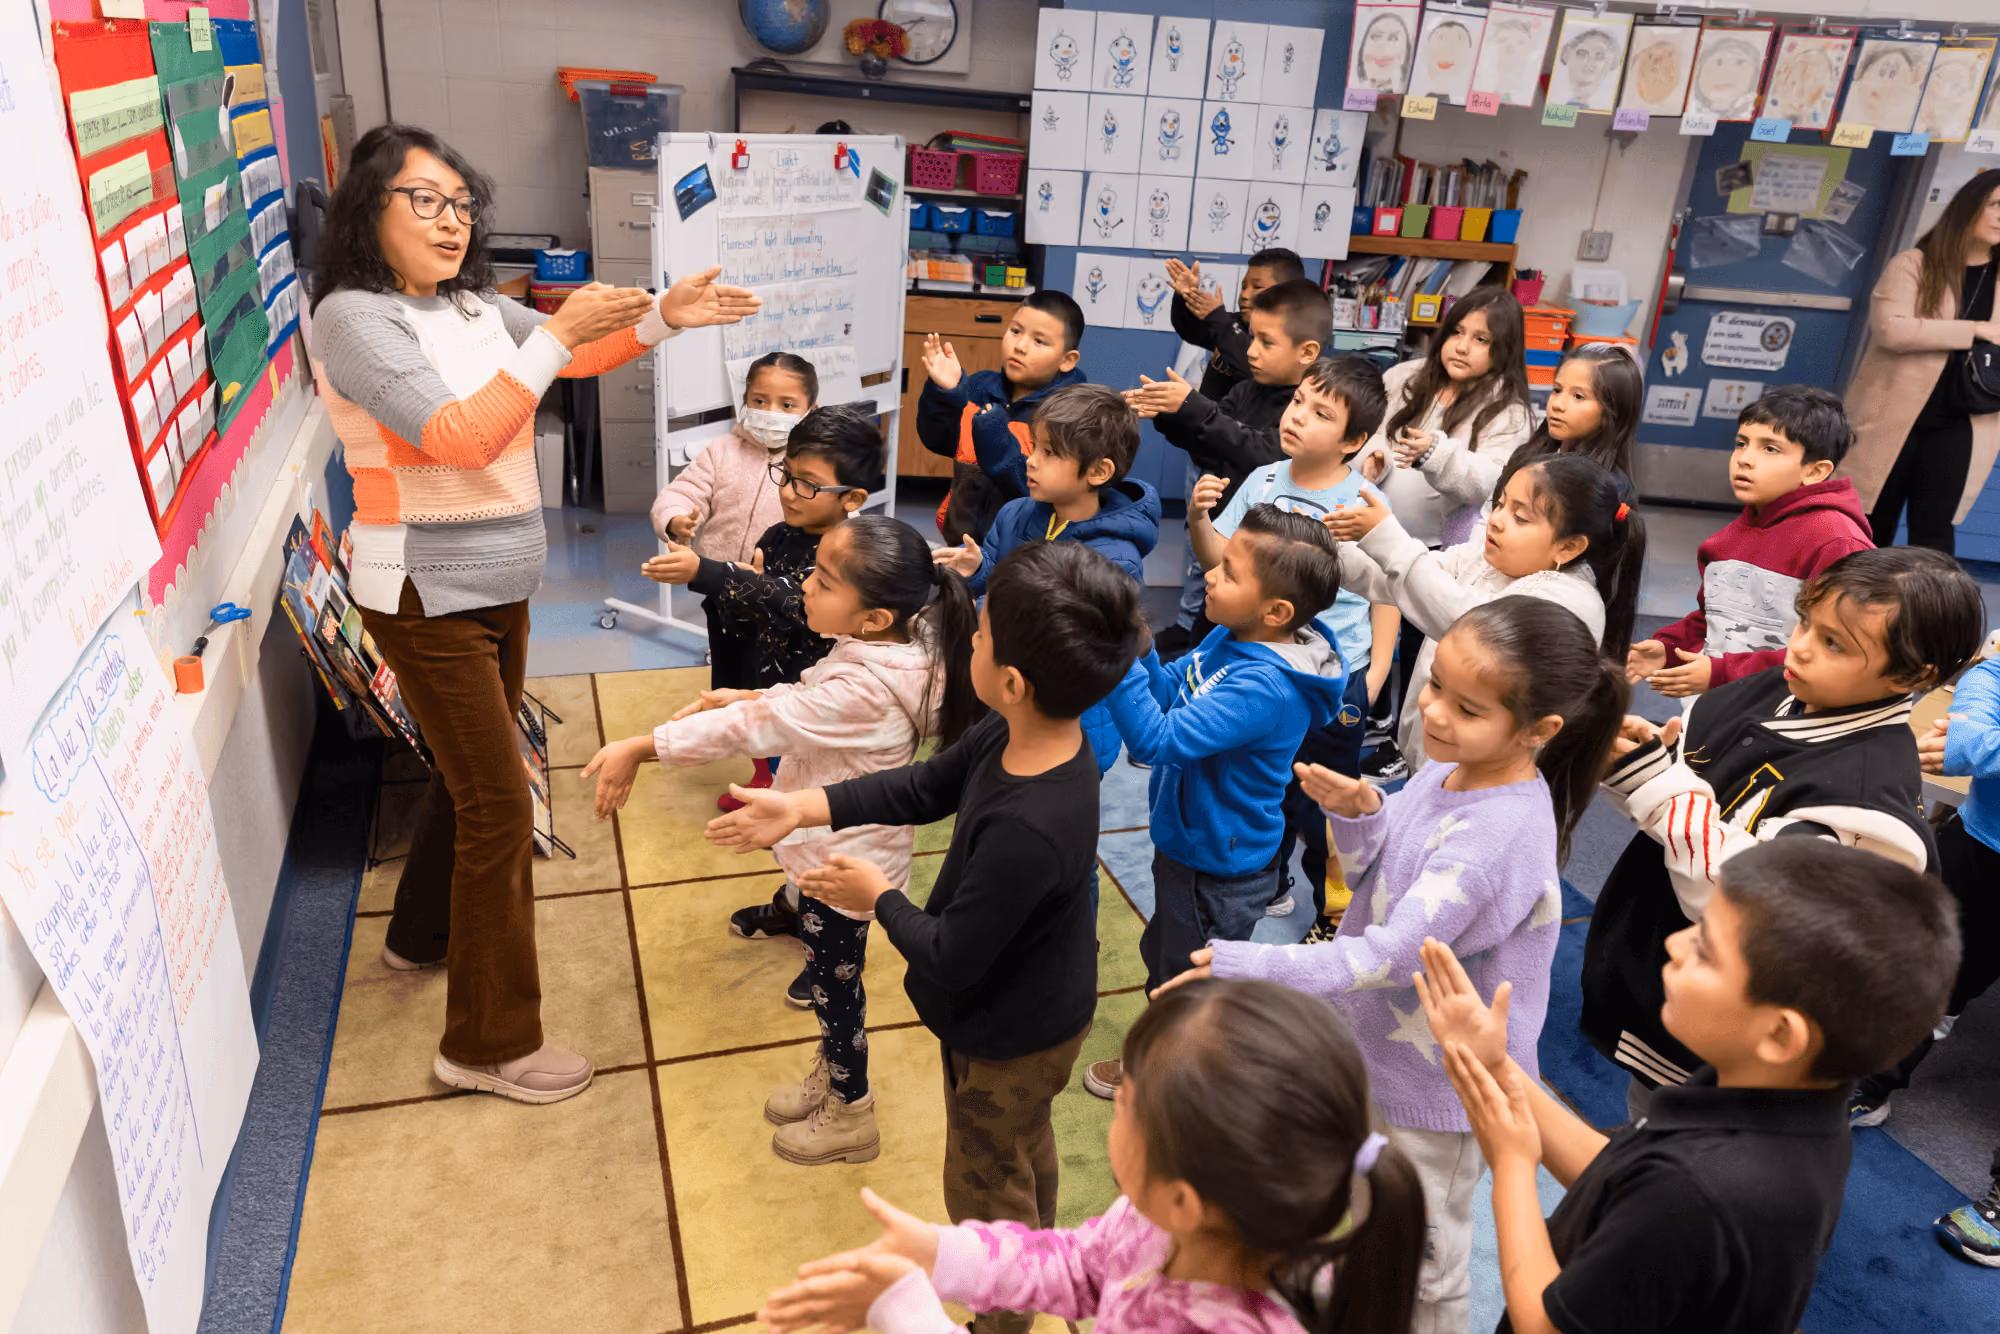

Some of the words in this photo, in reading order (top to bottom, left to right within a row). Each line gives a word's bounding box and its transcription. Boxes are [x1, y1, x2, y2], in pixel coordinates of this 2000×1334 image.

[777, 151, 799, 171] Light
[64, 396, 85, 426] una
[82, 371, 103, 410] luz
[72, 472, 105, 518] colores
[96, 647, 122, 702] sombra
[78, 687, 97, 725] la
[49, 725, 79, 765] luz
[75, 712, 90, 747] y
[94, 707, 126, 759] Quiero
[34, 750, 62, 792] La
[6, 849, 36, 897] Yo
[36, 826, 55, 869] sé
[65, 852, 85, 884] la
[76, 833, 101, 864] luz
[96, 796, 115, 836] del
[50, 924, 66, 968] sol
[88, 882, 96, 898] a
[92, 860, 109, 888] tus
[57, 947, 81, 991] debes
[80, 910, 98, 945] usar
[74, 992, 93, 1019] la
[82, 970, 106, 1000] luz
[89, 1018, 103, 1040] los
[119, 1136, 130, 1170] la
[129, 1117, 142, 1148] luz
[125, 1176, 136, 1202] la
[132, 1213, 141, 1241] la
[138, 1248, 149, 1276] la
[149, 1188, 172, 1250] sombra
